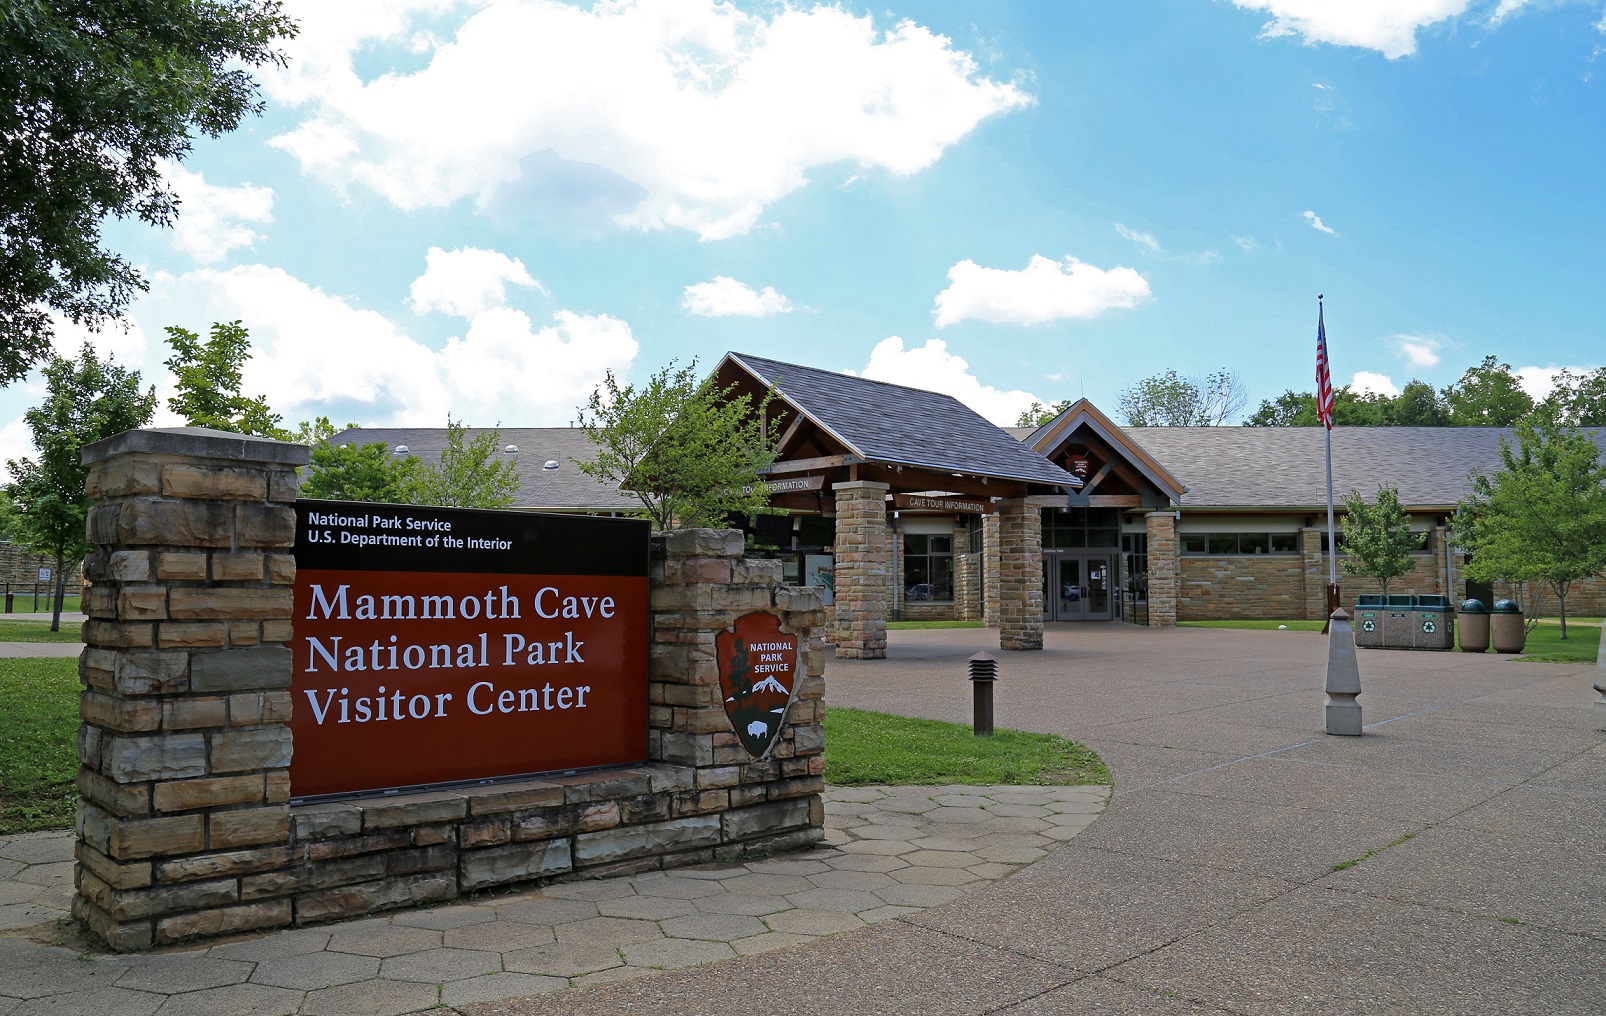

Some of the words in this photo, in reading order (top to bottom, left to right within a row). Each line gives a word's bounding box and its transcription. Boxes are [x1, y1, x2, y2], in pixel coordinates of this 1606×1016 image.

[909, 497, 926, 507] CAVE
[927, 500, 944, 508] TOUR
[945, 501, 984, 512] INFORMATION
[308, 512, 369, 528] National
[372, 515, 402, 530] Park
[406, 517, 452, 532] Service
[308, 529, 337, 544] U.S.
[340, 531, 423, 548] Department
[425, 534, 440, 547] of
[443, 535, 464, 548] the
[467, 536, 512, 550] Interior
[305, 584, 521, 620] Mammoth
[534, 586, 615, 619] Cave
[304, 631, 489, 672] National
[502, 631, 585, 666] Park
[750, 642, 792, 651] NATIONAL
[760, 653, 783, 662] PARK
[754, 663, 789, 673] SERVICE
[303, 685, 453, 725] Visitor
[466, 681, 591, 715] Center
